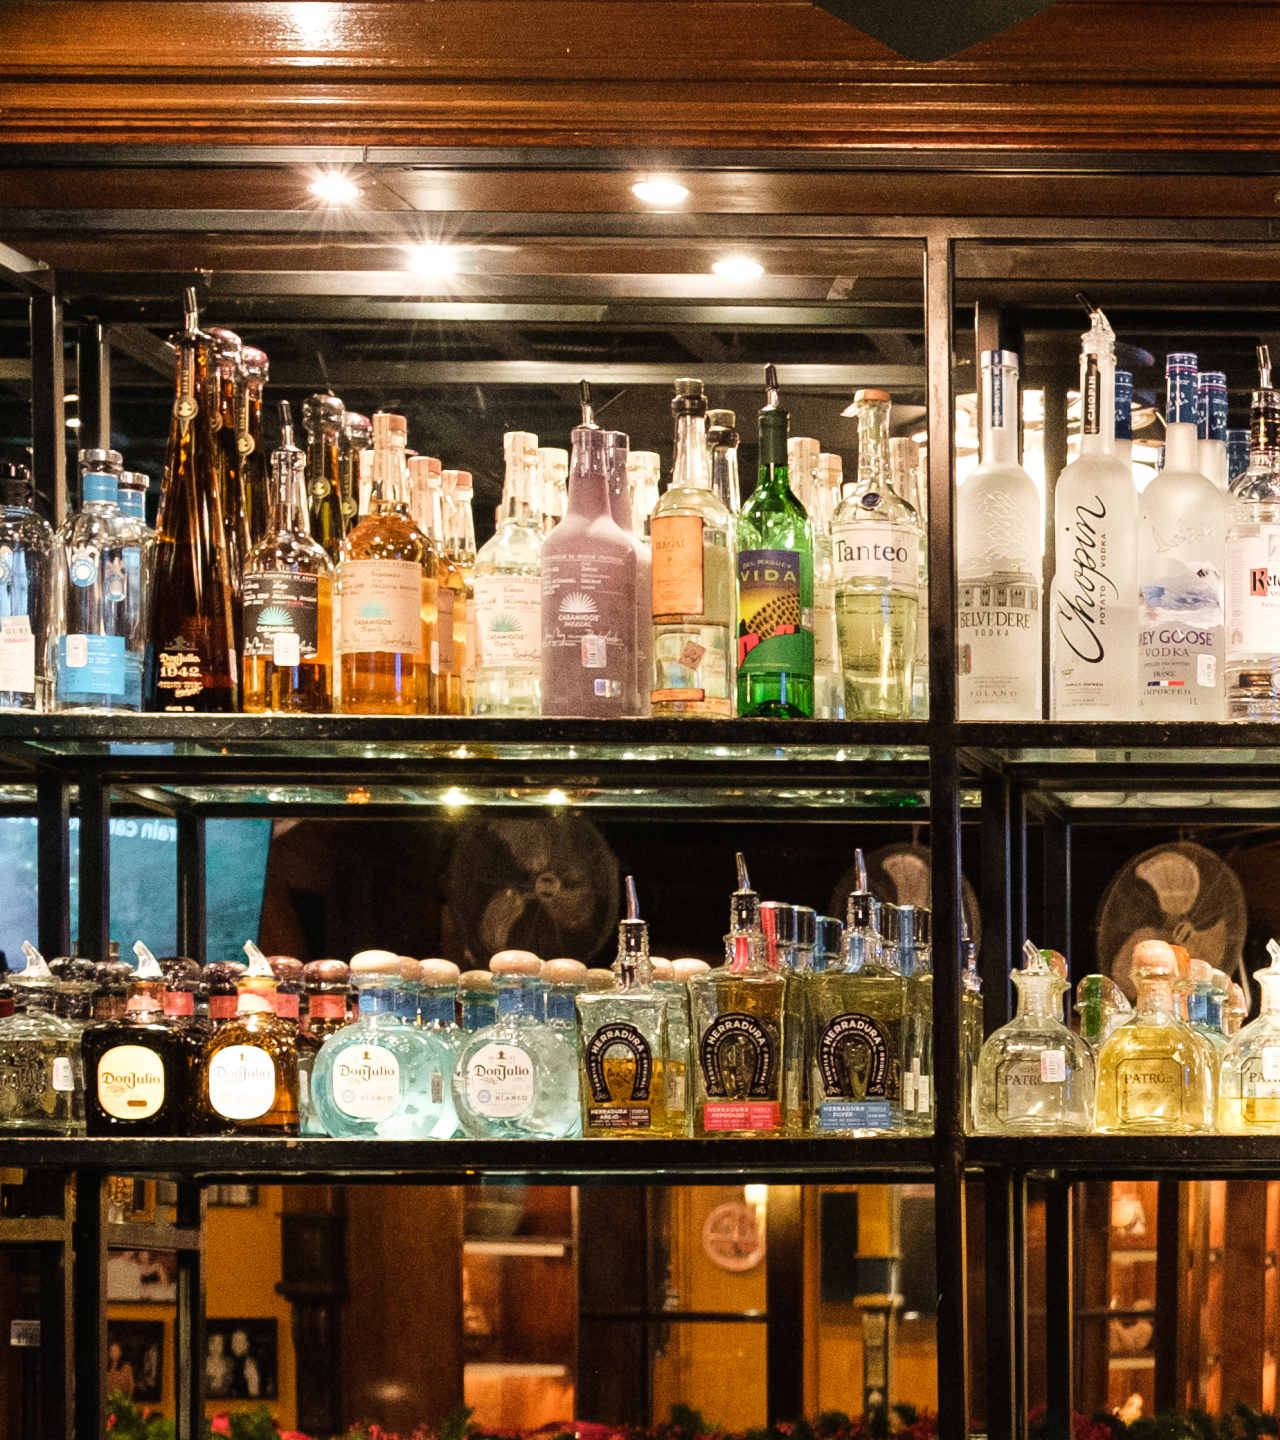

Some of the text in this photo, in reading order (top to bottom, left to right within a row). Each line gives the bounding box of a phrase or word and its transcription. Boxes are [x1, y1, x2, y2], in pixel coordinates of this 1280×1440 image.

[836, 539, 908, 563] Tanteo
[1099, 533, 1107, 567] VODKA
[740, 569, 797, 583] VIDA
[1057, 495, 1119, 663] Chopin
[960, 611, 1031, 630] BELVEDERE
[974, 629, 1010, 637] VODKA
[1139, 630, 1214, 646] EY GOOSE
[1145, 648, 1190, 657] VODKA
[159, 665, 202, 677] 1942
[591, 1029, 645, 1054] HERRADURA
[707, 1018, 767, 1046] HERRADURA
[823, 1019, 883, 1046] HERRADURA
